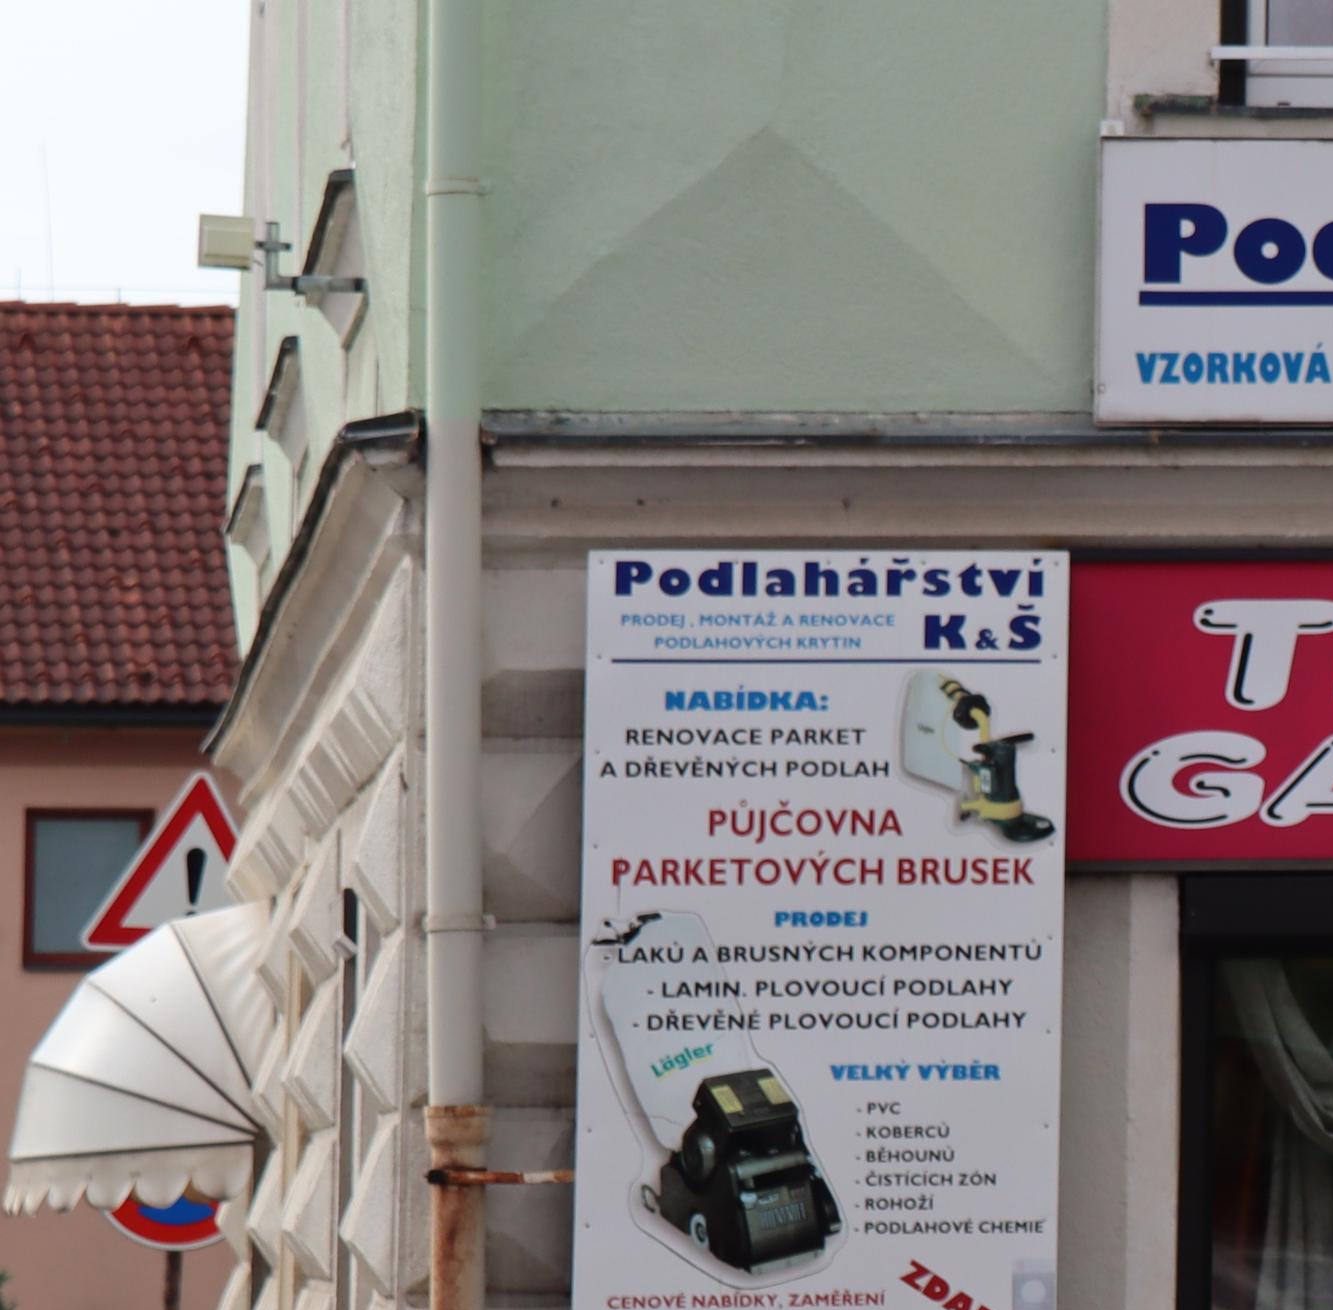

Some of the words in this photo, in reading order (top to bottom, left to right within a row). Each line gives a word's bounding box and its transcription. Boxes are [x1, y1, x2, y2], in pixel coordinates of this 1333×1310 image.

[1137, 342, 1332, 384] VZORKOVÁ
[615, 558, 1044, 597] Podlahářství
[700, 611, 777, 628] MONTÁŽ
[782, 614, 794, 628] A
[800, 614, 895, 628] RENOVACE
[654, 633, 791, 650] PODLAHOVÝCH
[797, 635, 861, 650] KRYTIN
[665, 685, 829, 712] NABÍDKA:
[626, 728, 764, 746] RENOVACE
[772, 728, 866, 745] PARKET
[600, 761, 616, 779] A
[626, 755, 777, 779] DŘEVĚNÝCH
[786, 761, 890, 778] PODLAH
[709, 800, 903, 844] PŮJČOVNA
[612, 851, 884, 887] PARKETOVÝCH
[897, 859, 1034, 886] BRUSEK
[775, 911, 868, 927] PRODEJ
[618, 940, 684, 964] LAKŮ
[693, 945, 709, 963] A
[718, 940, 854, 962] BRUSNÝCH
[863, 938, 1042, 961] KOMPONENTŮ
[662, 981, 747, 999] LAMIN.
[756, 975, 885, 997] PLOVOUCÍ
[894, 979, 1014, 996] PODLAHY
[647, 1008, 761, 1031] DŘEVĚNÉ
[769, 1007, 899, 1030] PLOVOUCÍ
[907, 1012, 1028, 1029] PODLAHY
[650, 1042, 715, 1079] Lägler
[830, 1059, 911, 1080] VELKÝ
[918, 1059, 1001, 1080] VÝBĚR
[867, 1103, 901, 1116] PVC
[866, 1124, 950, 1139] KOBERCŮ
[866, 1149, 955, 1164] BĚHOUNŮ
[865, 1171, 953, 1187] ČISTÍCÍCH
[959, 1172, 997, 1187] ZÓN
[865, 1196, 935, 1211] ROHOŽÍ
[864, 1218, 977, 1235] PODLAHOVÉ
[979, 1219, 1044, 1234] CHEMIE
[607, 1293, 686, 1310] CENOVÉ
[692, 1290, 782, 1309] NABÍDKY,
[788, 1289, 886, 1308] ZAMĚŘENÍ
